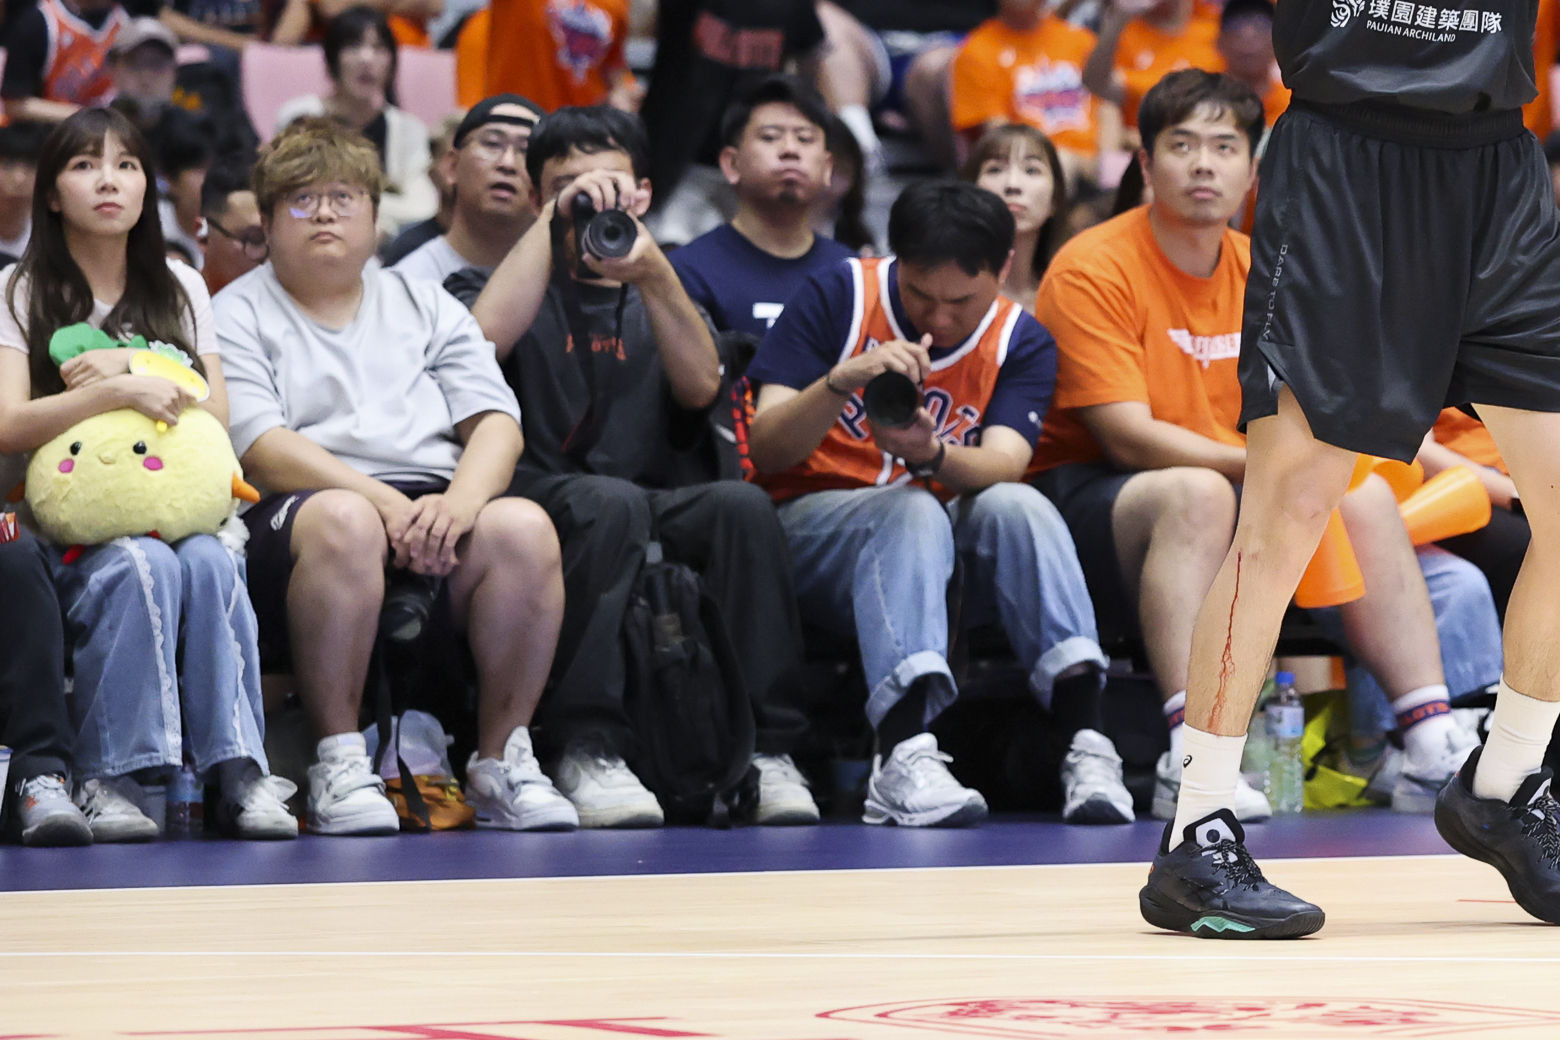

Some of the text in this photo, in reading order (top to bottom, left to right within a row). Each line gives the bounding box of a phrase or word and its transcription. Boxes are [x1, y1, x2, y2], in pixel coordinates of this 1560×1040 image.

[1366, 19, 1456, 43] PAUIAN ARCHILAND
[1272, 244, 1288, 287] DARE
[1263, 312, 1274, 340] FLY
